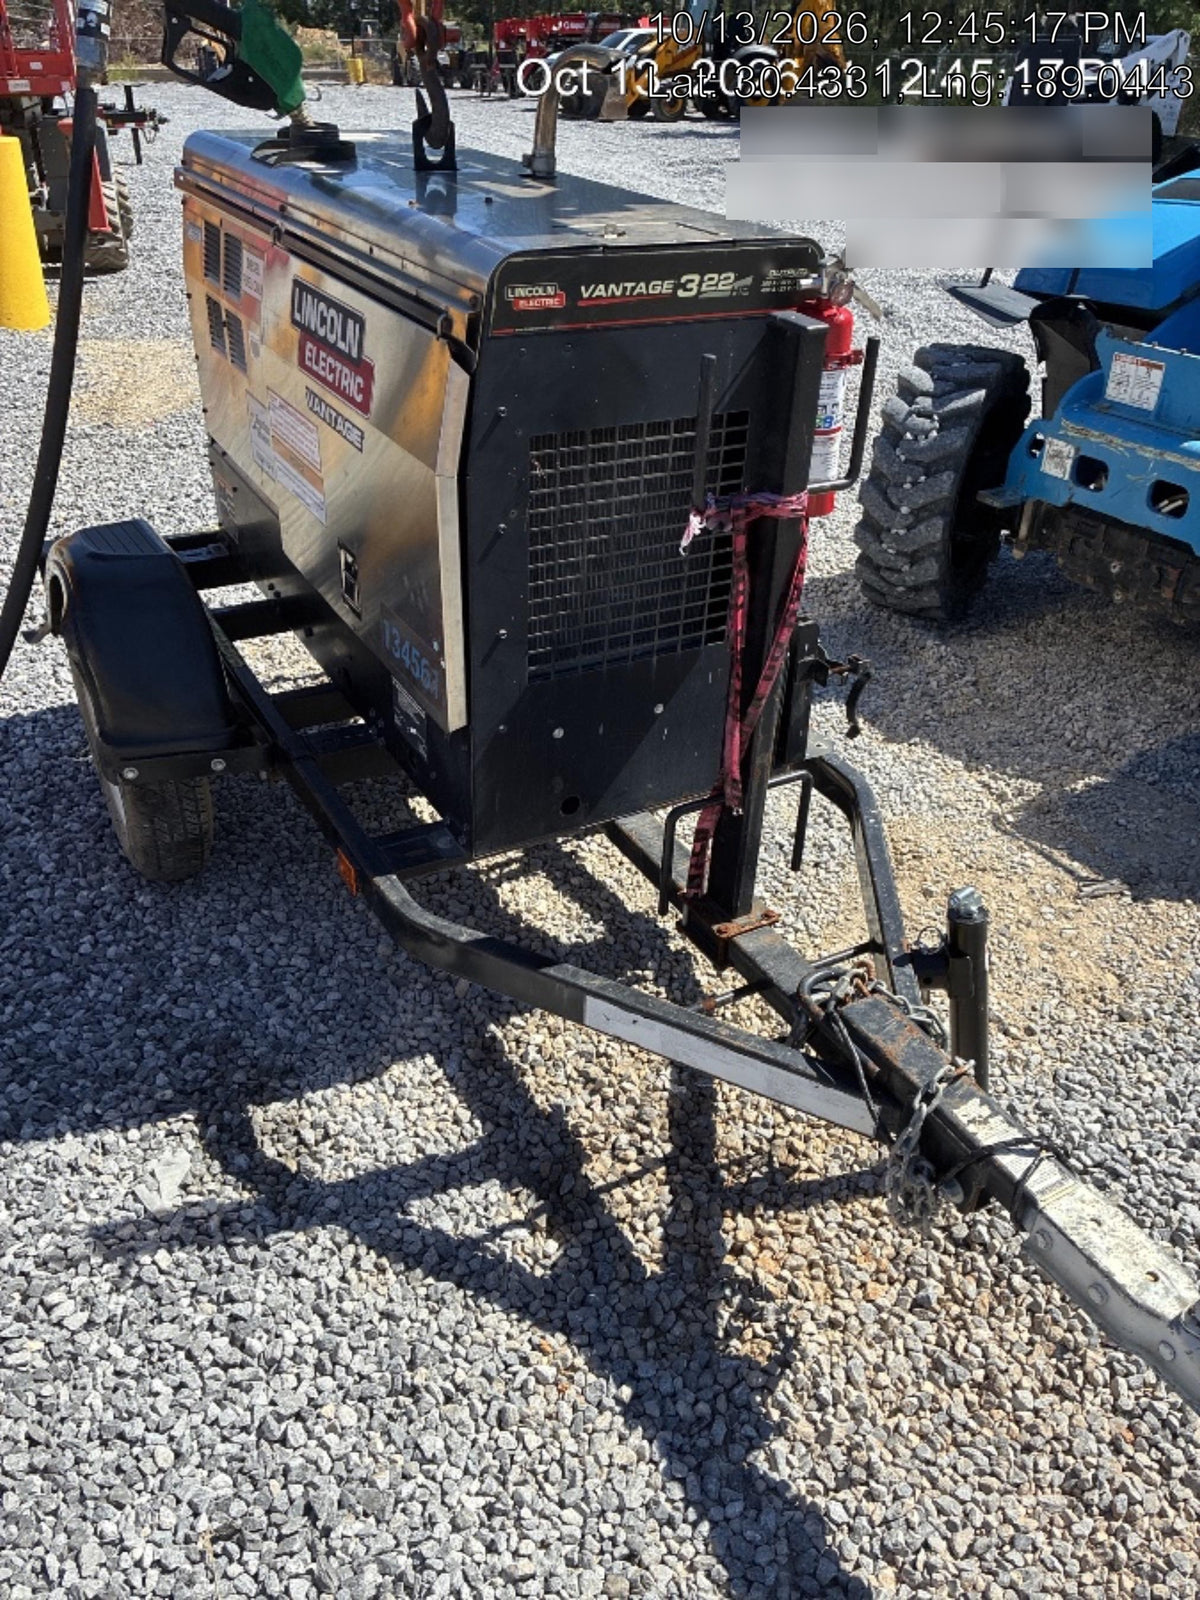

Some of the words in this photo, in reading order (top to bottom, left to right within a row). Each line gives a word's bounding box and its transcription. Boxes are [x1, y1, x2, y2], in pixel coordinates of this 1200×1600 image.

[507, 284, 557, 298] LINCOLN
[518, 297, 562, 308] ELECTRIC
[579, 279, 675, 299] VANTAGE
[676, 271, 736, 298] 322
[293, 286, 361, 359] LINCOLN
[304, 341, 366, 405] ELECTRIC
[306, 389, 363, 450] VANTAGE
